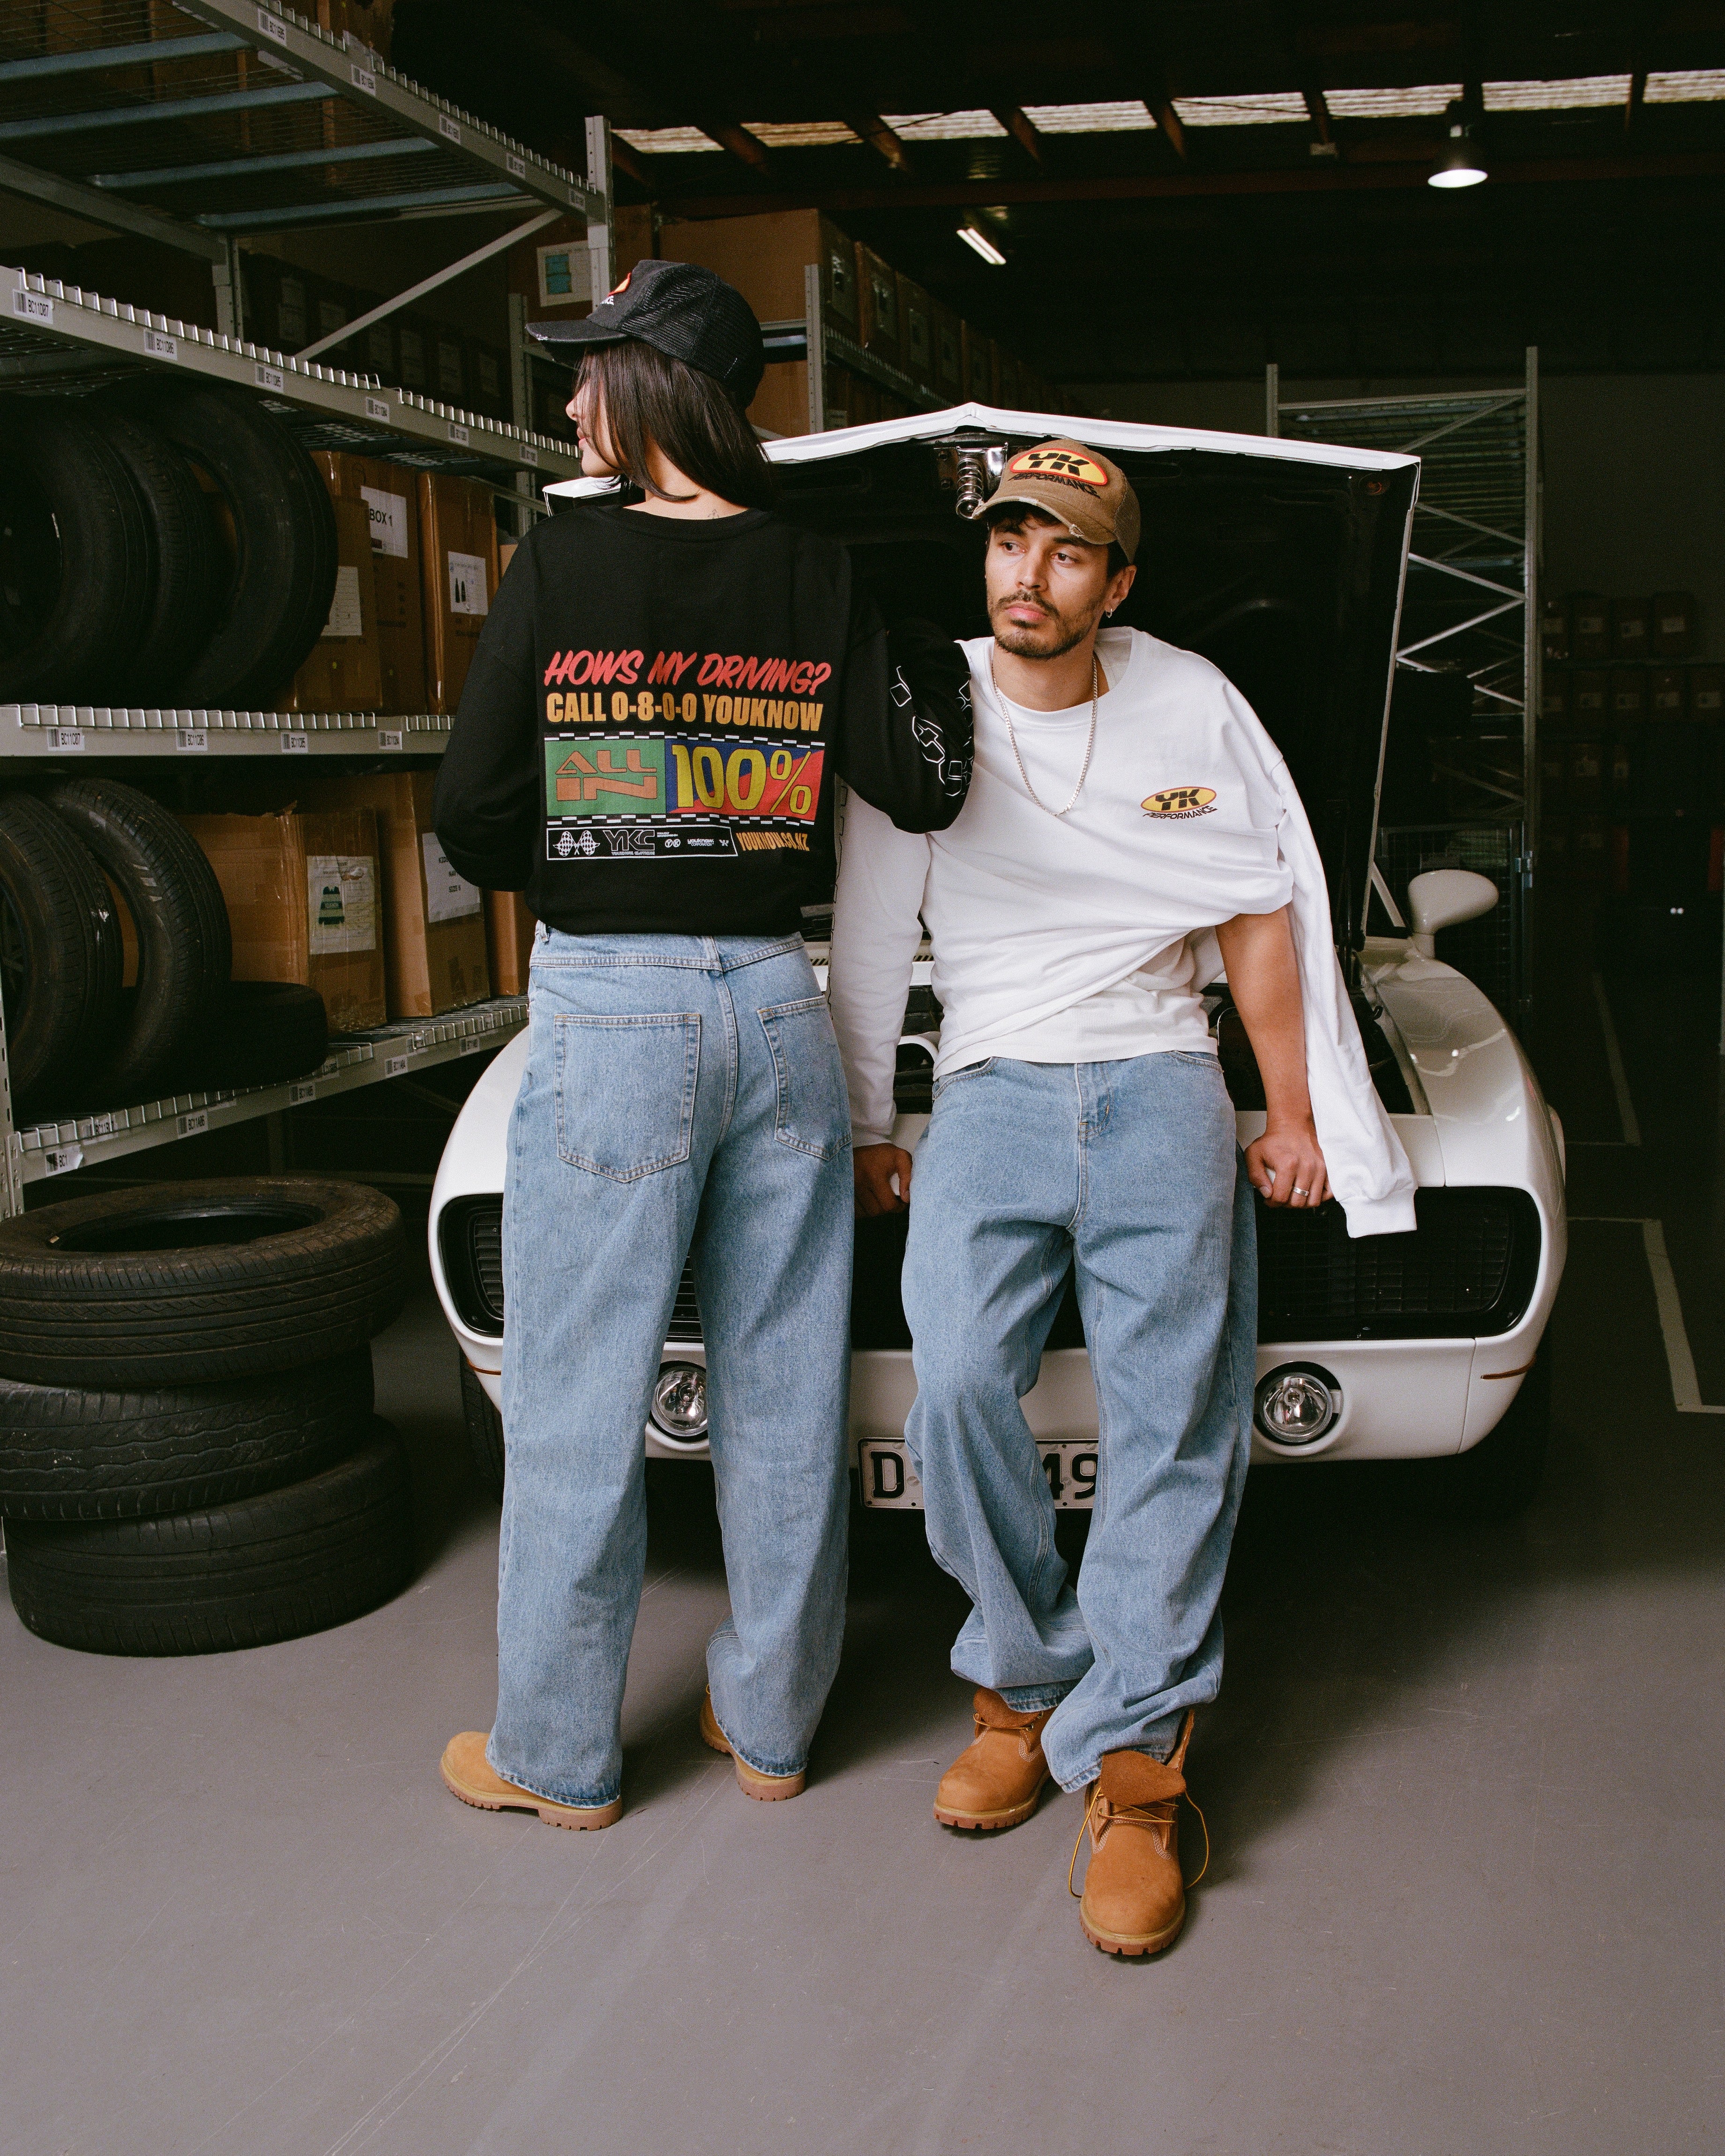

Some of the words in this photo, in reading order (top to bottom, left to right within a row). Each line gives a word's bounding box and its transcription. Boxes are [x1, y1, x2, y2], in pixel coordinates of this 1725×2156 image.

[28, 299, 49, 318] BC11D07
[157, 338, 174, 354] BC11D06
[1028, 453, 1090, 477] YK
[370, 508, 387, 525] BOX
[389, 515, 393, 527] 1
[544, 650, 644, 687] HOWS
[648, 651, 697, 685] MY
[697, 653, 831, 696] DRIVING?
[547, 691, 606, 722] CALL
[703, 694, 824, 732] YOUKNOW
[61, 733, 81, 745] BC11C07
[188, 735, 204, 746] BC11C06
[556, 750, 657, 774] ALL
[672, 744, 812, 814] 100%
[1155, 788, 1200, 811] YK
[1143, 805, 1217, 819] PERFORMANCE
[603, 829, 655, 851] YKC
